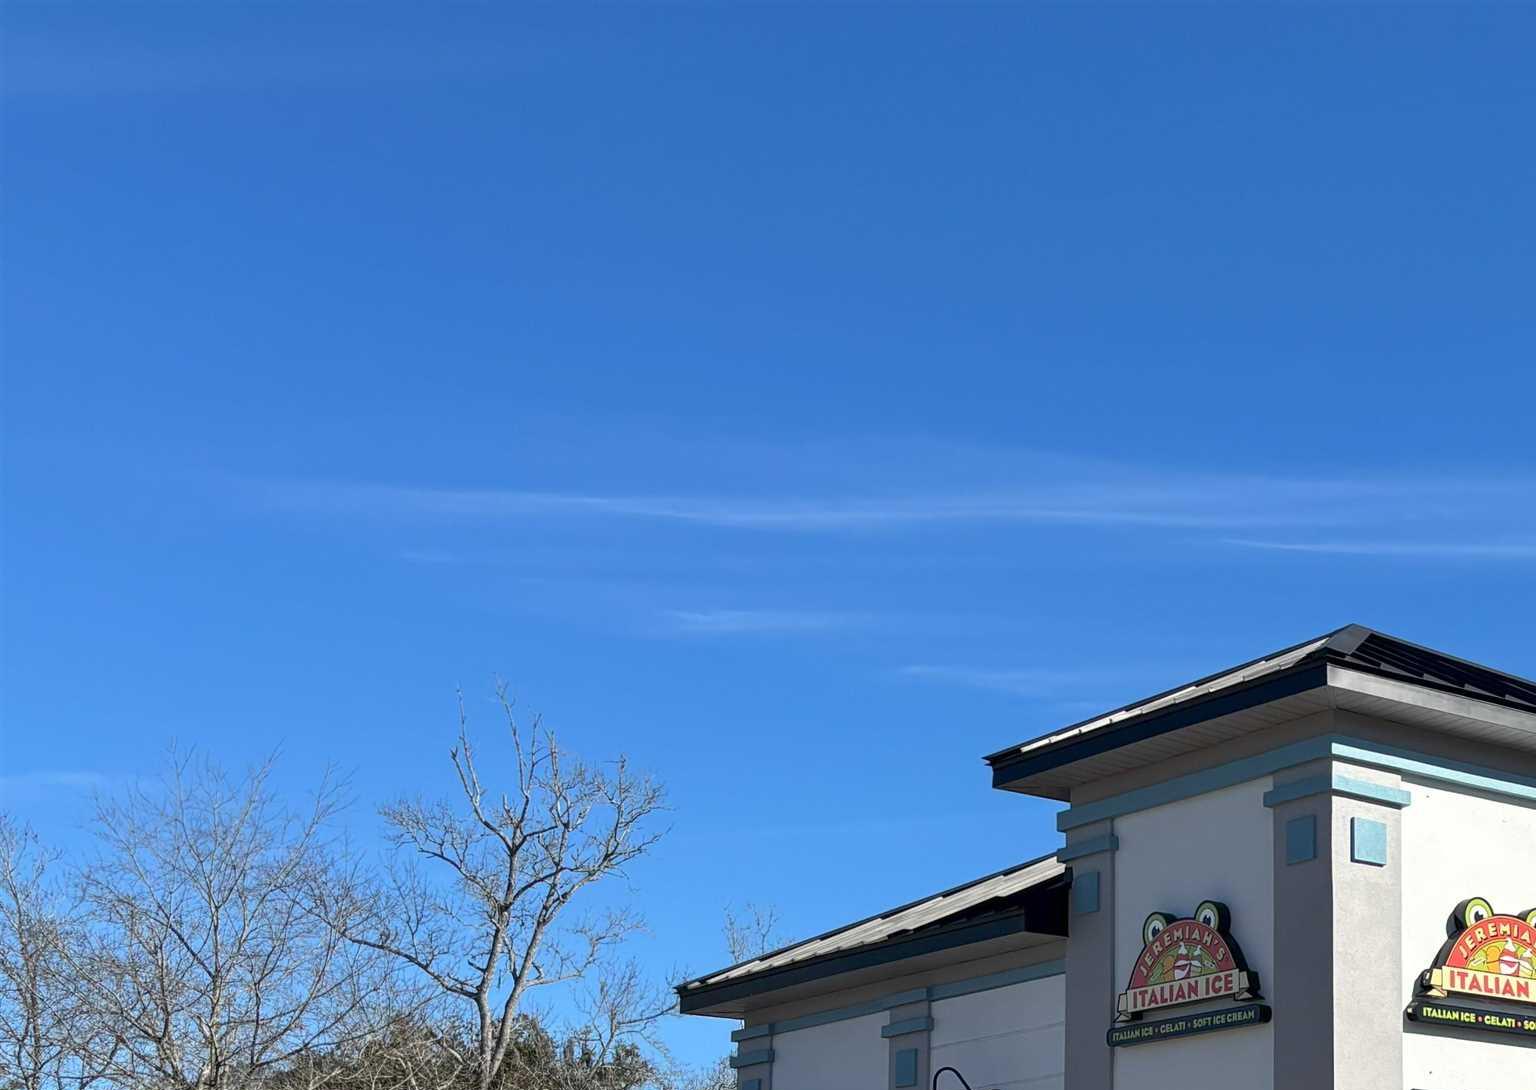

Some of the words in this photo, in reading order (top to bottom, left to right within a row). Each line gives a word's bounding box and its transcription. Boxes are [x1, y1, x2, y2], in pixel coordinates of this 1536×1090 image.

[1139, 927, 1226, 977] JEREMIAH'S
[1132, 980, 1199, 1009] ITALIAN
[1205, 973, 1234, 997] ICE
[1449, 970, 1529, 998] ITALIAN
[1112, 1027, 1142, 1041] ITALIAN
[1142, 1026, 1153, 1038] ICE
[1160, 1022, 1186, 1034] GELATI
[1193, 1018, 1213, 1029] SOFT
[1213, 1015, 1227, 1025] ICE
[1227, 1010, 1255, 1023] CREAM
[1422, 1007, 1460, 1021] ITALIAN
[1460, 1011, 1476, 1023] ICE
[1484, 1014, 1516, 1028] GELATI
